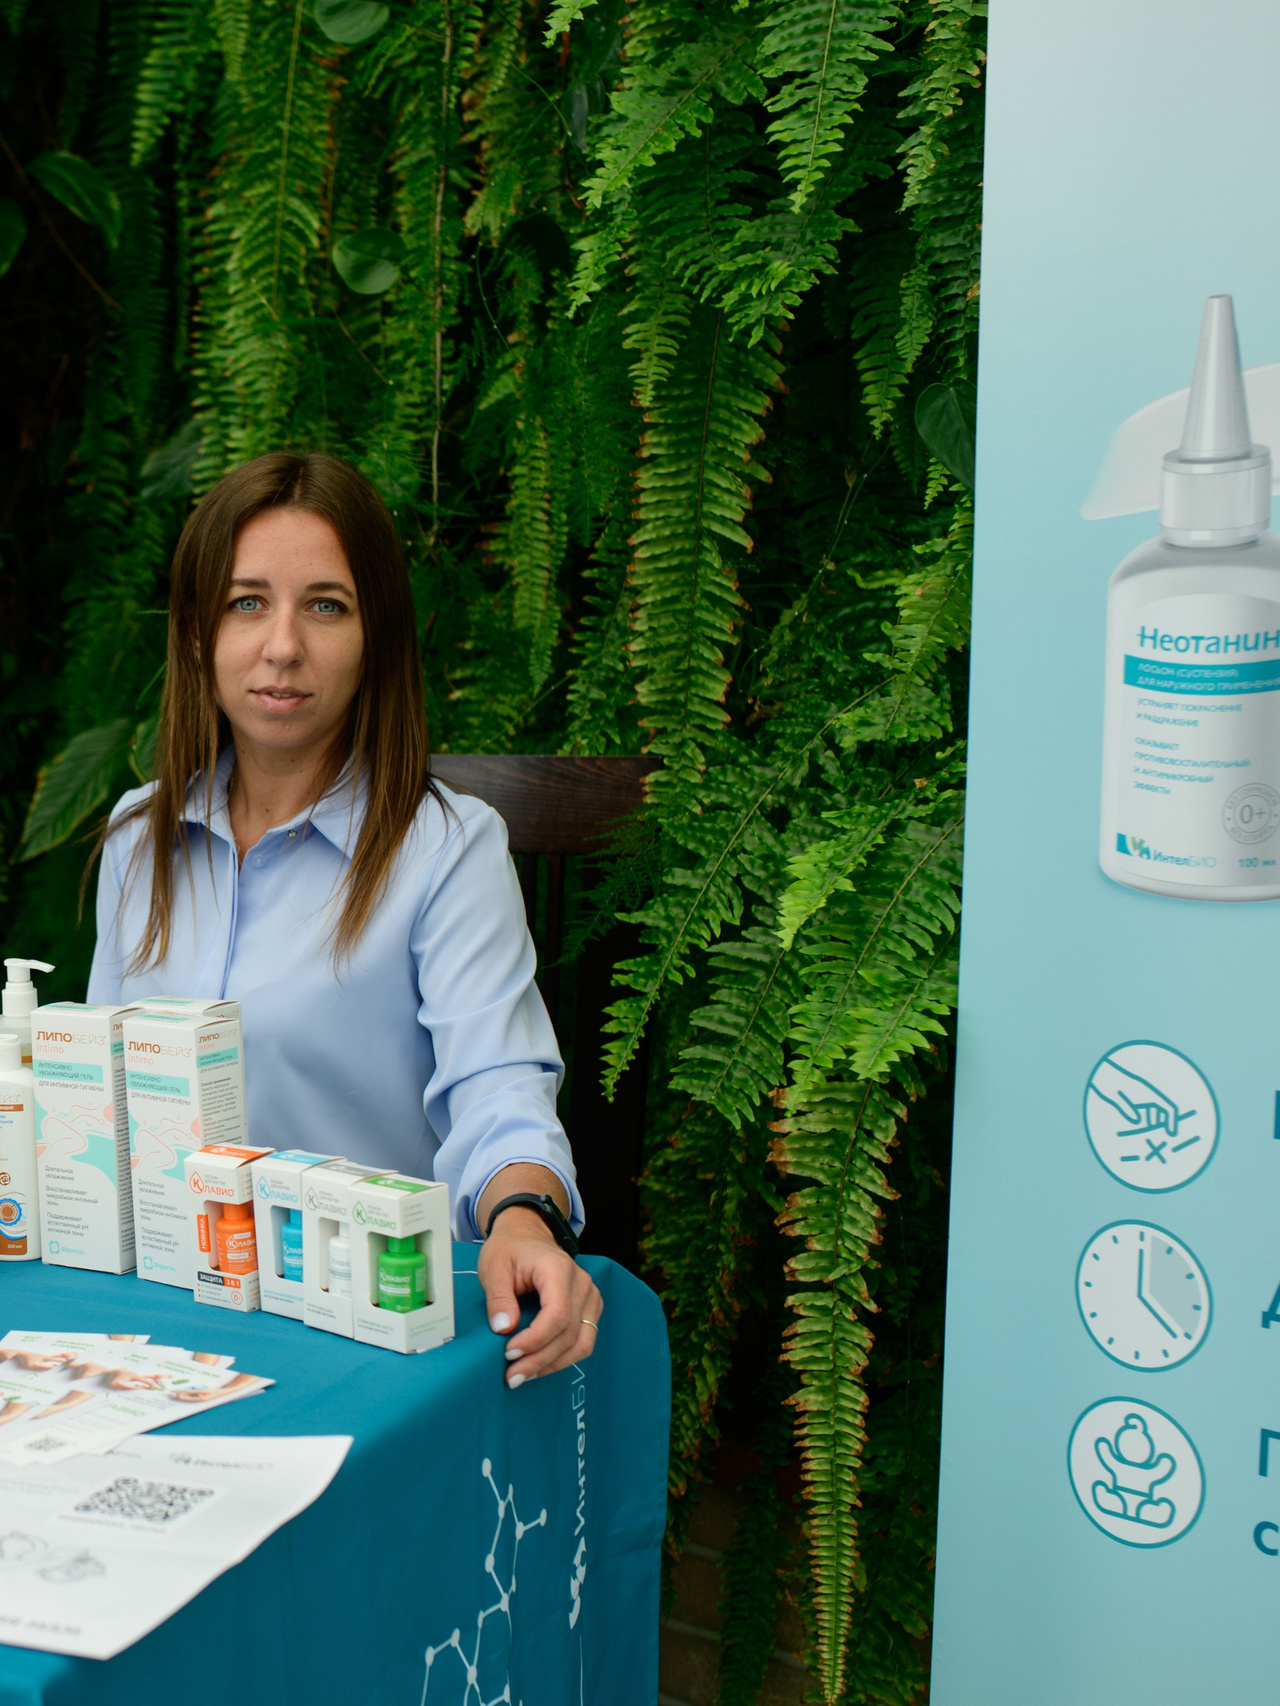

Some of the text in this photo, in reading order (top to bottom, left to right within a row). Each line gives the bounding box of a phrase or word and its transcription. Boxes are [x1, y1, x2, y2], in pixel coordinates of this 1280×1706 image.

[1136, 625, 1280, 655] Неотанин
[1137, 662, 1176, 677] ЛОСЬОН
[1136, 675, 1217, 692] ДЛЯ НАРУЖНОГО
[1152, 849, 1217, 869] ИнтелБИО
[1238, 857, 1259, 868] 100
[36, 1031, 106, 1046] ЛИПОБЕЙЗ
[36, 1042, 64, 1054] intimo
[128, 1041, 192, 1058] ЛИПОБЕЙЗ
[38, 1062, 72, 1071] ИНТЕНСИВНО
[128, 1055, 154, 1065] intimo
[39, 1070, 80, 1079] УВЛАЖНЯЮЩИЙ
[130, 1074, 161, 1083] ИНТЕНСИВНО
[50, 1081, 79, 1090] ИНТИМНОЙ
[80, 1084, 104, 1092] ГИГИЕНЫ
[130, 1081, 168, 1092] УВЛАЖНЯЮЩИЙ
[140, 1093, 167, 1103] ИНТИМНОЙ
[168, 1097, 191, 1106] ГИГИЕНЫ
[45, 1164, 74, 1175] Длительное
[46, 1185, 87, 1195] Восстанавливает
[192, 1176, 234, 1197] КЛАВИО
[258, 1180, 298, 1203] КЛАВИО
[308, 1196, 347, 1216] КЛАВИО
[47, 1212, 82, 1223] Поддерживает
[356, 1206, 398, 1230] КЛАВИО
[199, 1272, 224, 1285] ЗАЩИТА
